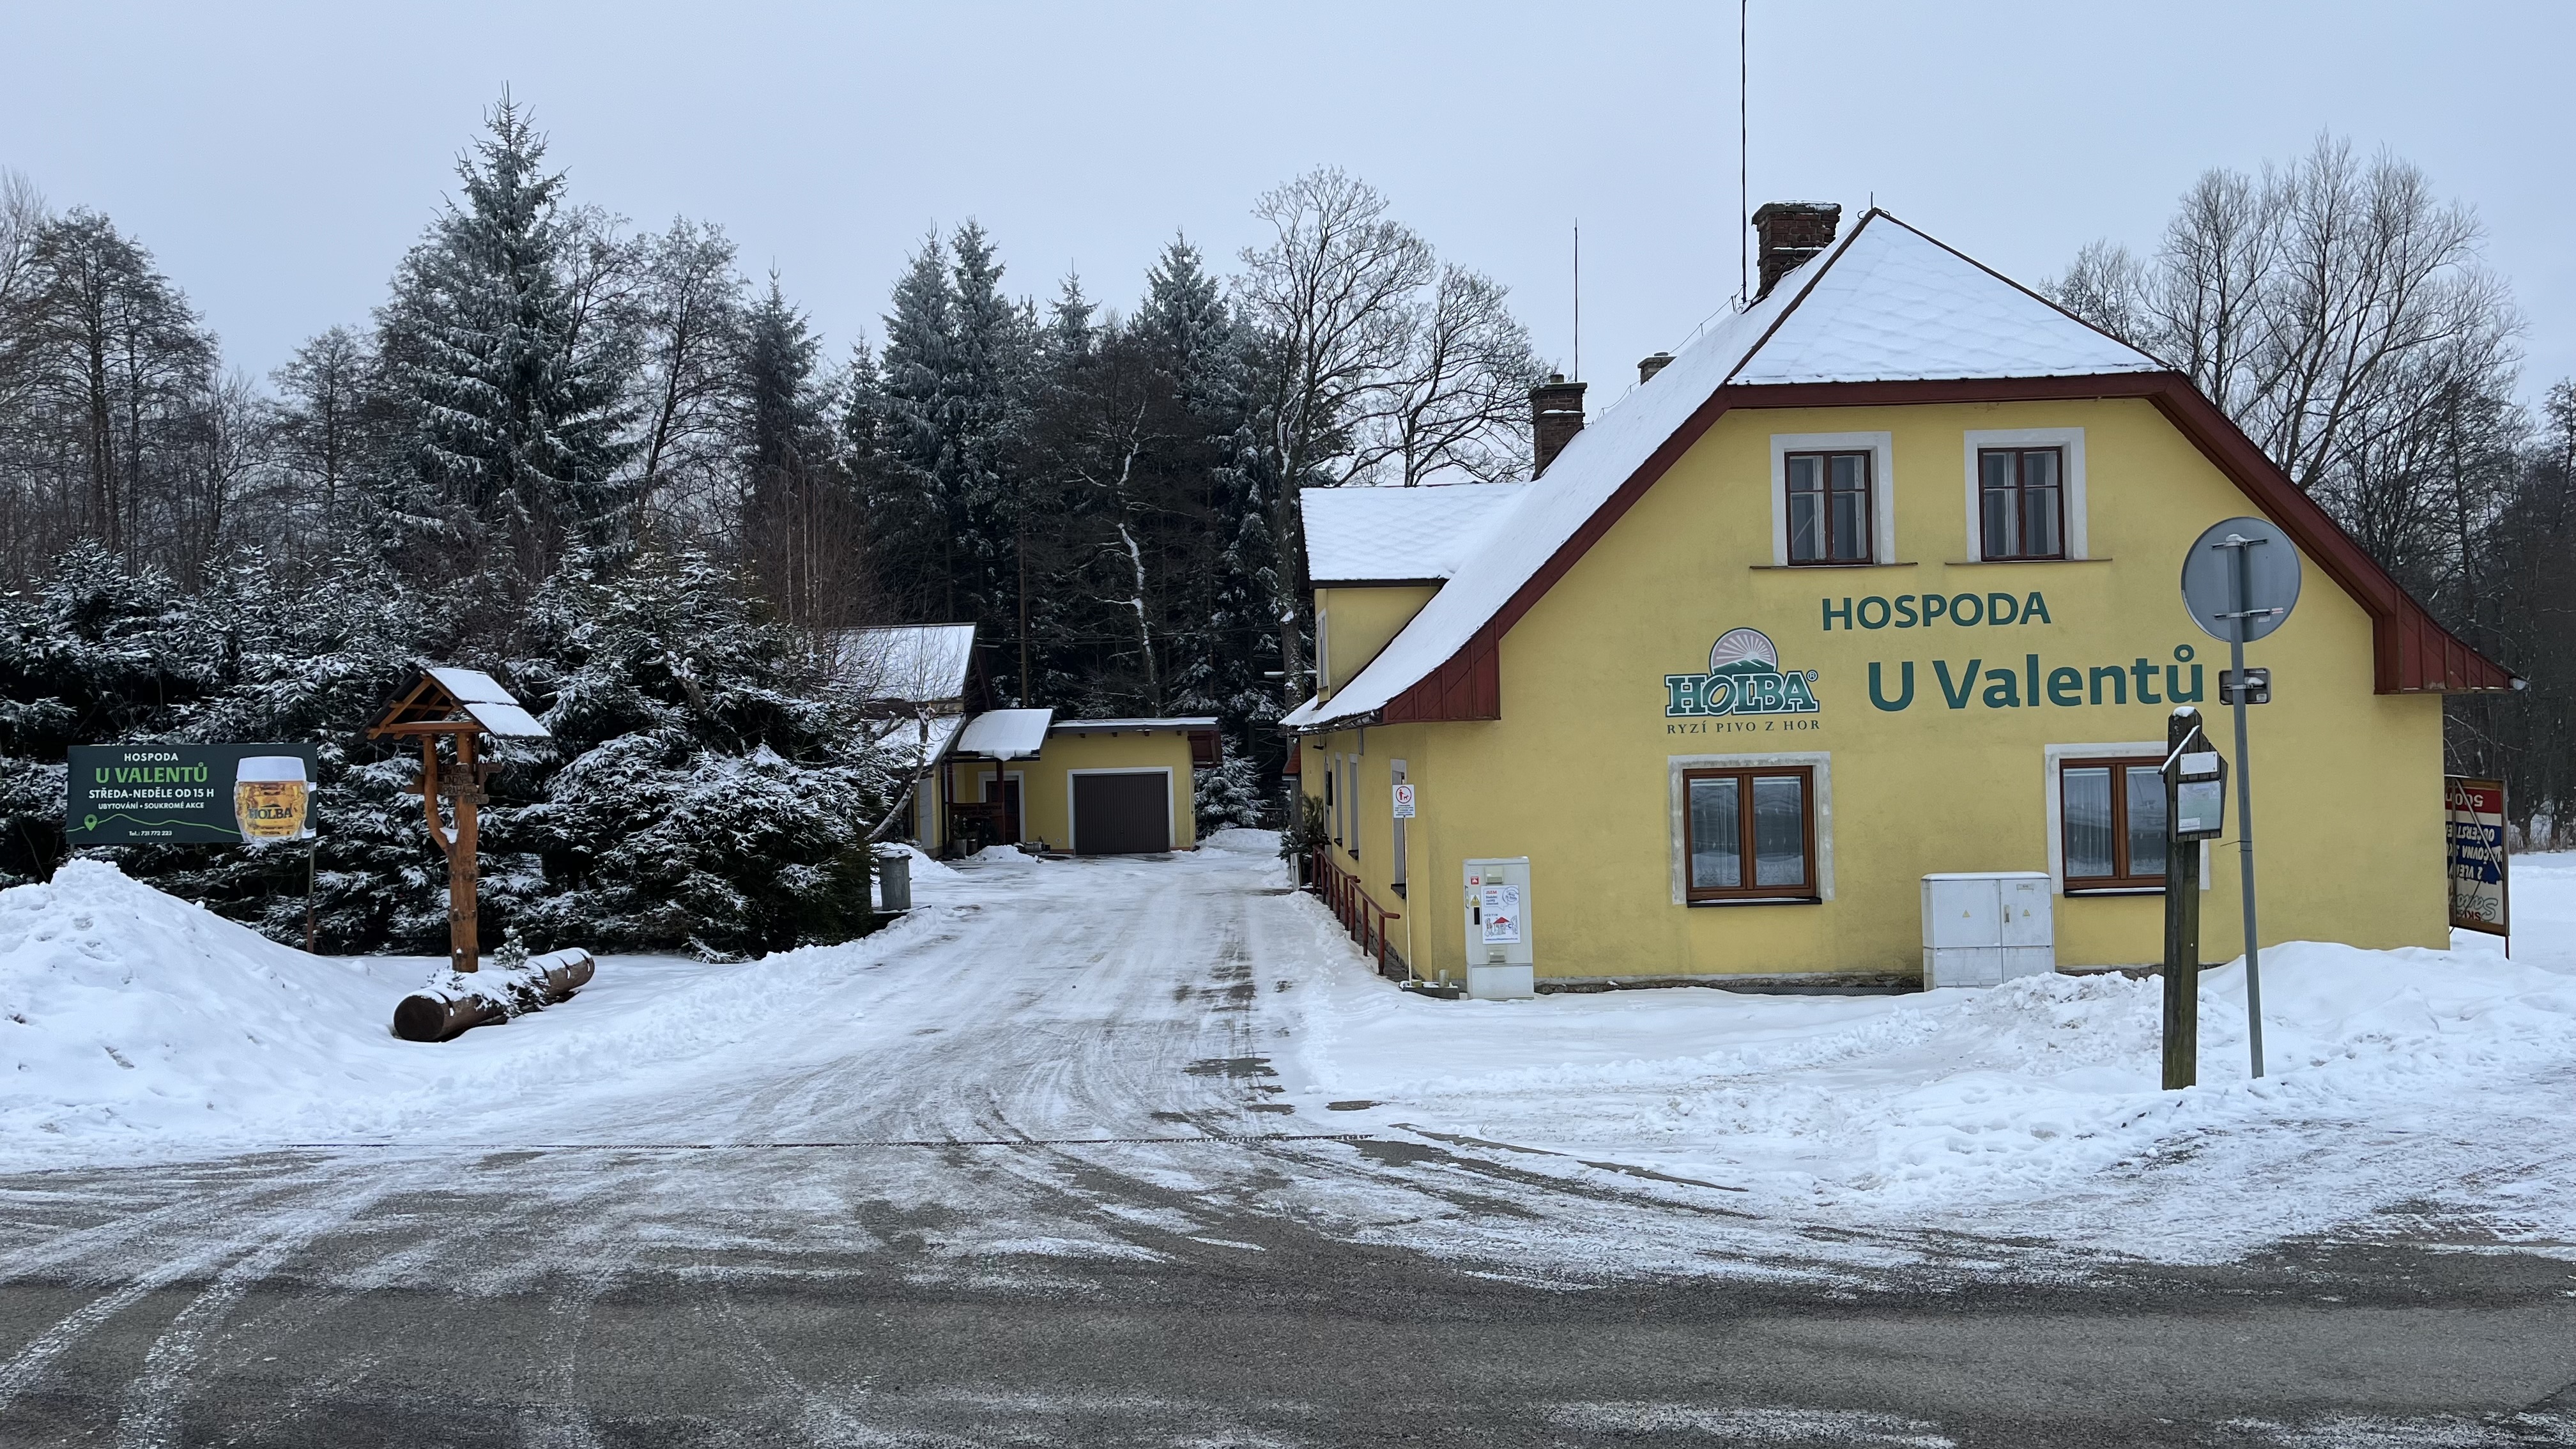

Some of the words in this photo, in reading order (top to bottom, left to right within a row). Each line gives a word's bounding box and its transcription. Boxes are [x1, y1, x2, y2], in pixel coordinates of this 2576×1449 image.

[1822, 592, 2051, 631] HOSPODA
[1868, 661, 1914, 712] U
[1933, 644, 2204, 710] Valentů
[1666, 720, 1707, 734] RYZÍ
[1716, 722, 1756, 733] PIVO
[1765, 721, 1775, 731] Z
[1783, 720, 1820, 731] HOR
[124, 753, 179, 762] HOSPODA
[95, 767, 110, 784] U
[116, 762, 208, 783] VALENTŮ
[88, 786, 173, 799] STŘEDA-NEDĚLE
[174, 788, 192, 798] OD
[193, 788, 204, 798] 15
[206, 788, 215, 798] H
[443, 786, 466, 795] PRAHA
[98, 801, 139, 809] UBYTOVÁNÍ
[144, 801, 185, 809] SOUKROMÉ
[248, 807, 293, 819] HOLBA
